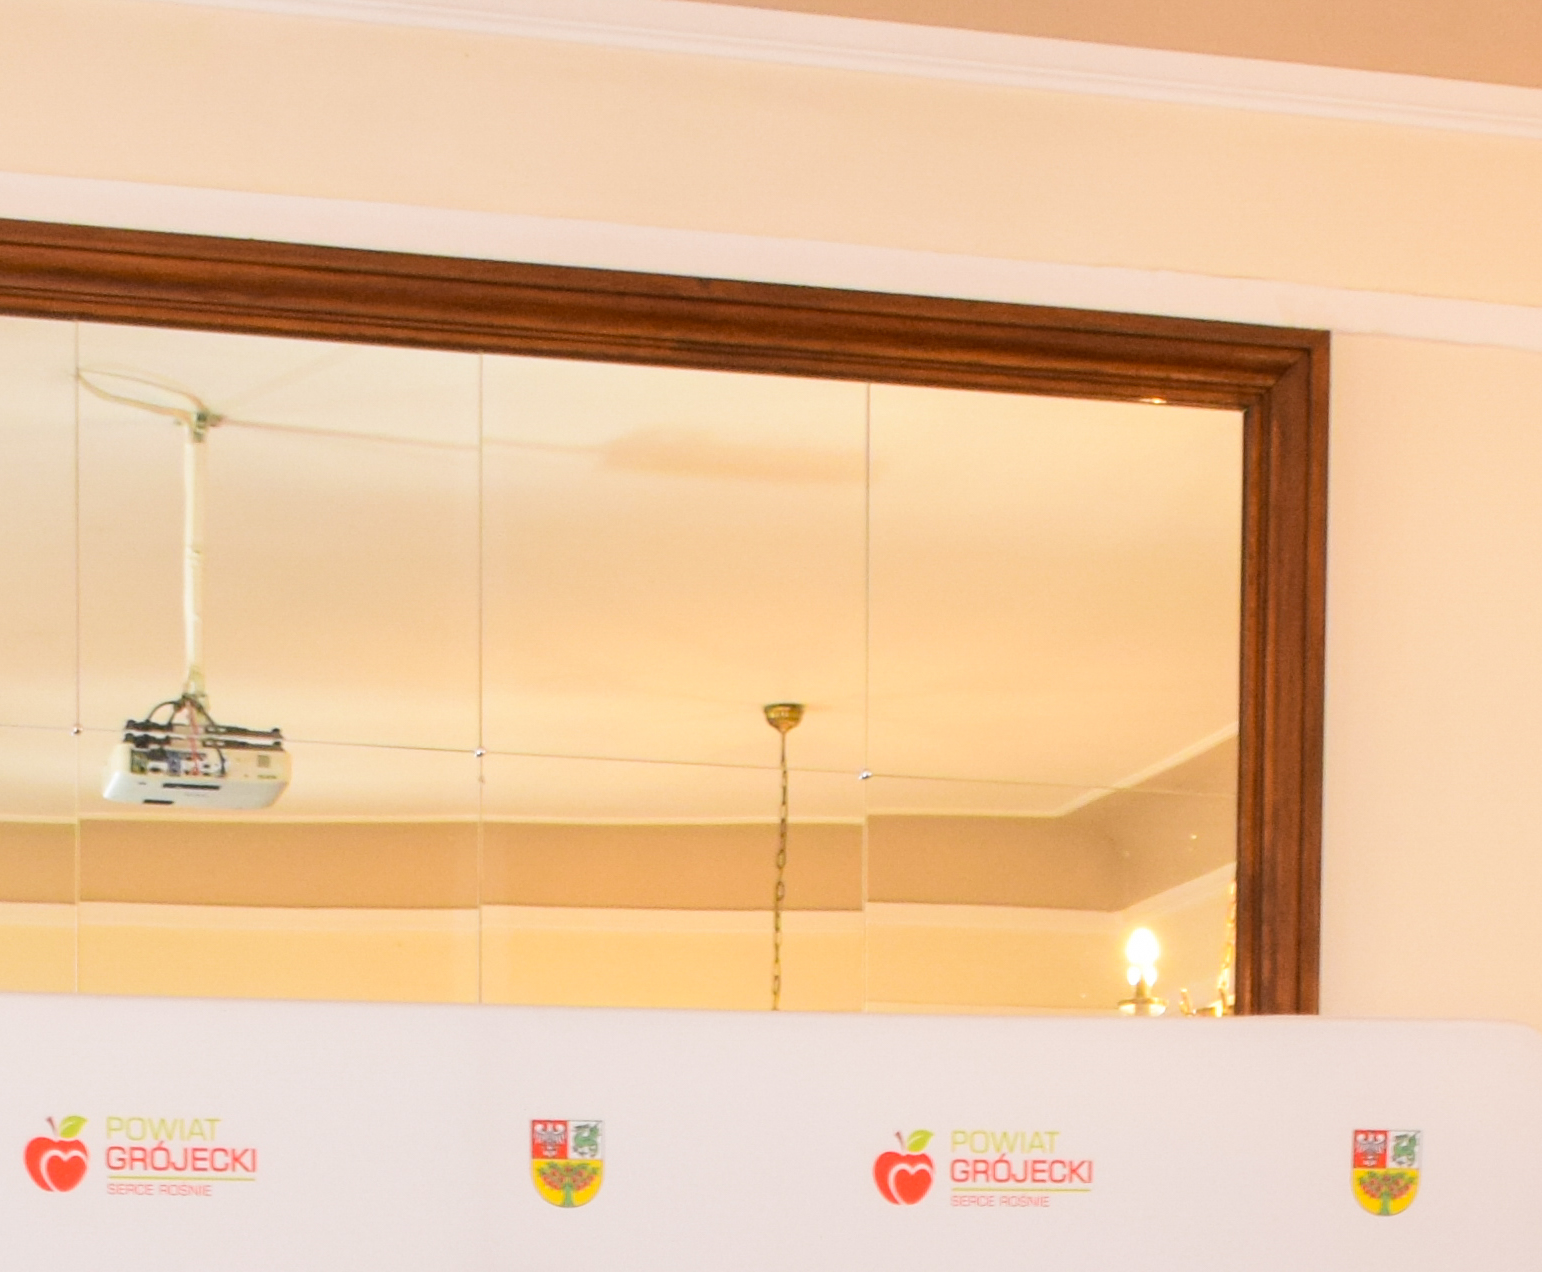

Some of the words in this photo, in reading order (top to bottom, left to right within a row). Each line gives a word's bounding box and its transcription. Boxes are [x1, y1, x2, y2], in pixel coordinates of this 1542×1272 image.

[106, 1116, 222, 1141] POWIAT
[950, 1130, 1060, 1154] POWIAT
[106, 1141, 257, 1173] GRÓJECKI
[950, 1153, 1093, 1183] GRÓJECKI
[107, 1183, 154, 1196] SERCE
[159, 1181, 212, 1197] ROŚNIE
[950, 1195, 995, 1207] SERCE
